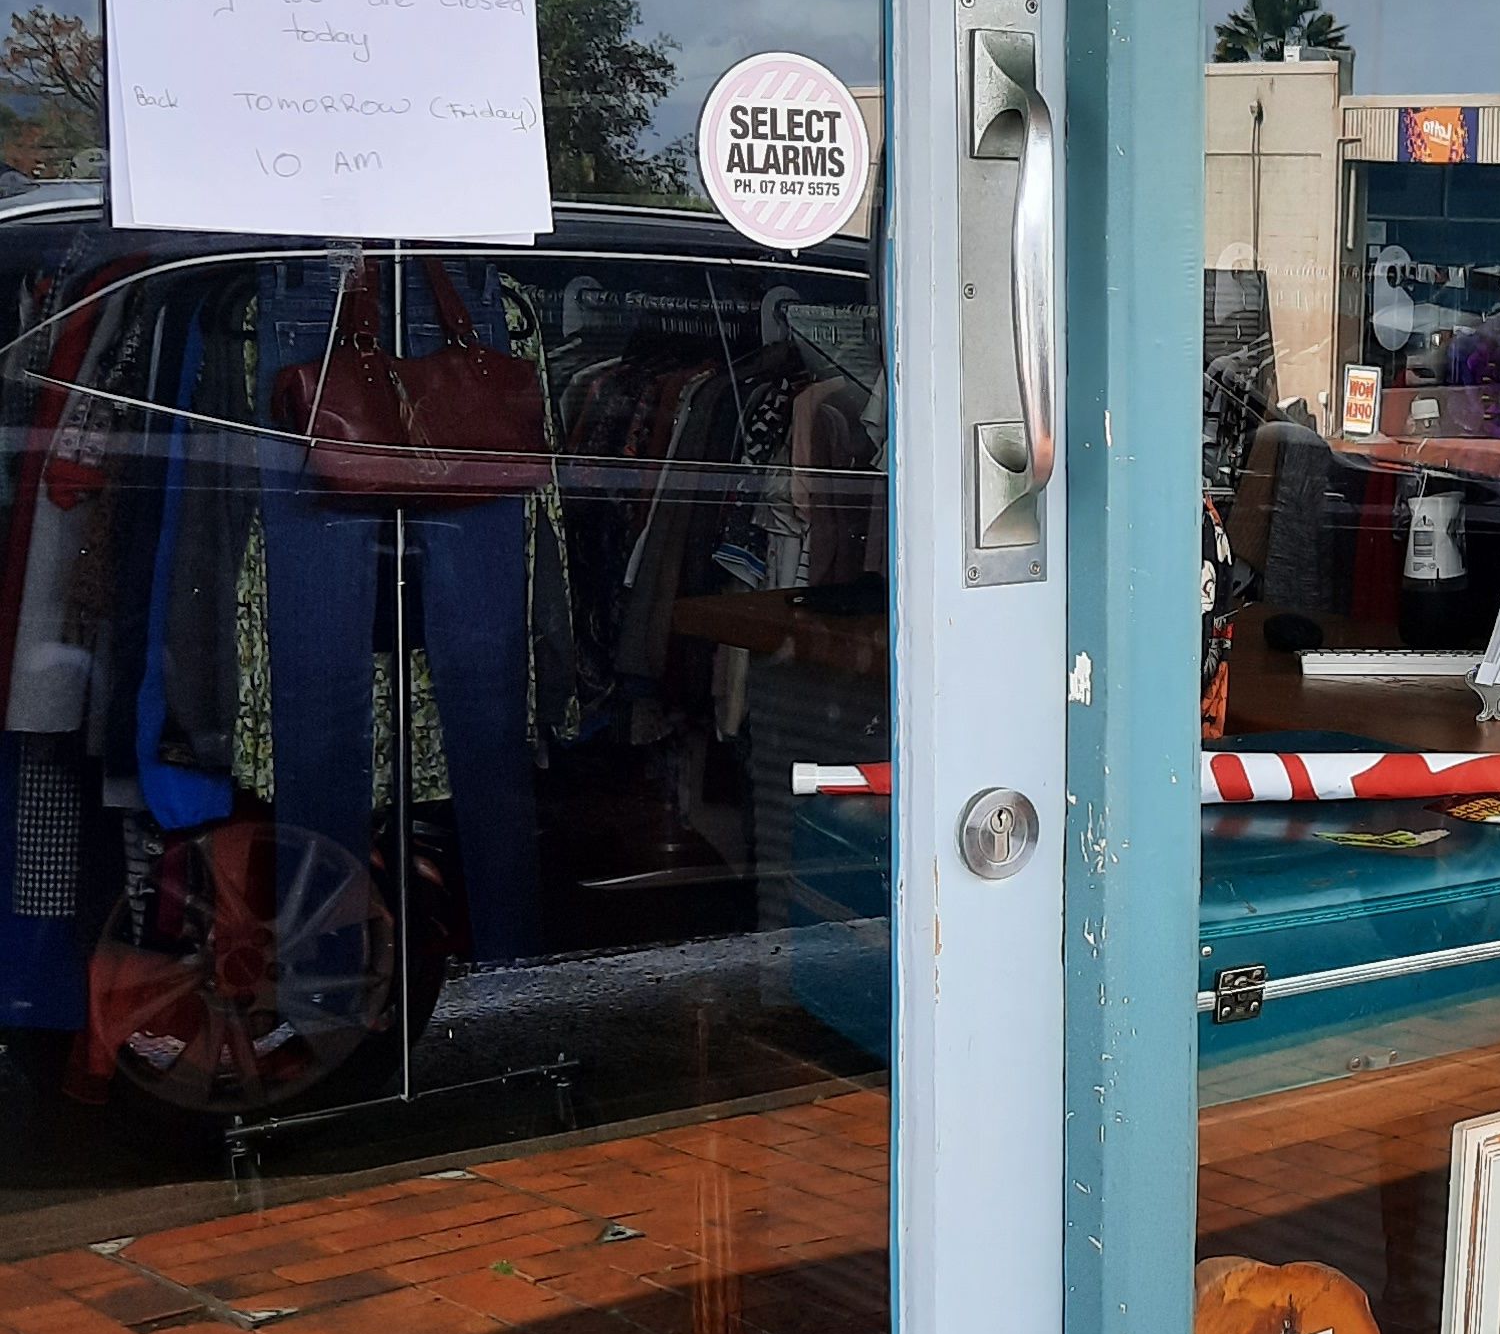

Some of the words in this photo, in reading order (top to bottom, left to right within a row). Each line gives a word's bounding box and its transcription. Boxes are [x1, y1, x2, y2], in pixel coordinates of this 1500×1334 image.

[281, 12, 373, 64] today
[133, 85, 179, 110] Back
[429, 95, 538, 133] (Friday)
[729, 104, 842, 144] SELECT
[254, 147, 301, 179] 10
[334, 150, 384, 175] AM
[725, 141, 846, 179] ALARMS
[733, 178, 756, 195] PH.
[759, 179, 777, 195] 07
[780, 180, 805, 196] 847
[807, 181, 841, 197] 5575
